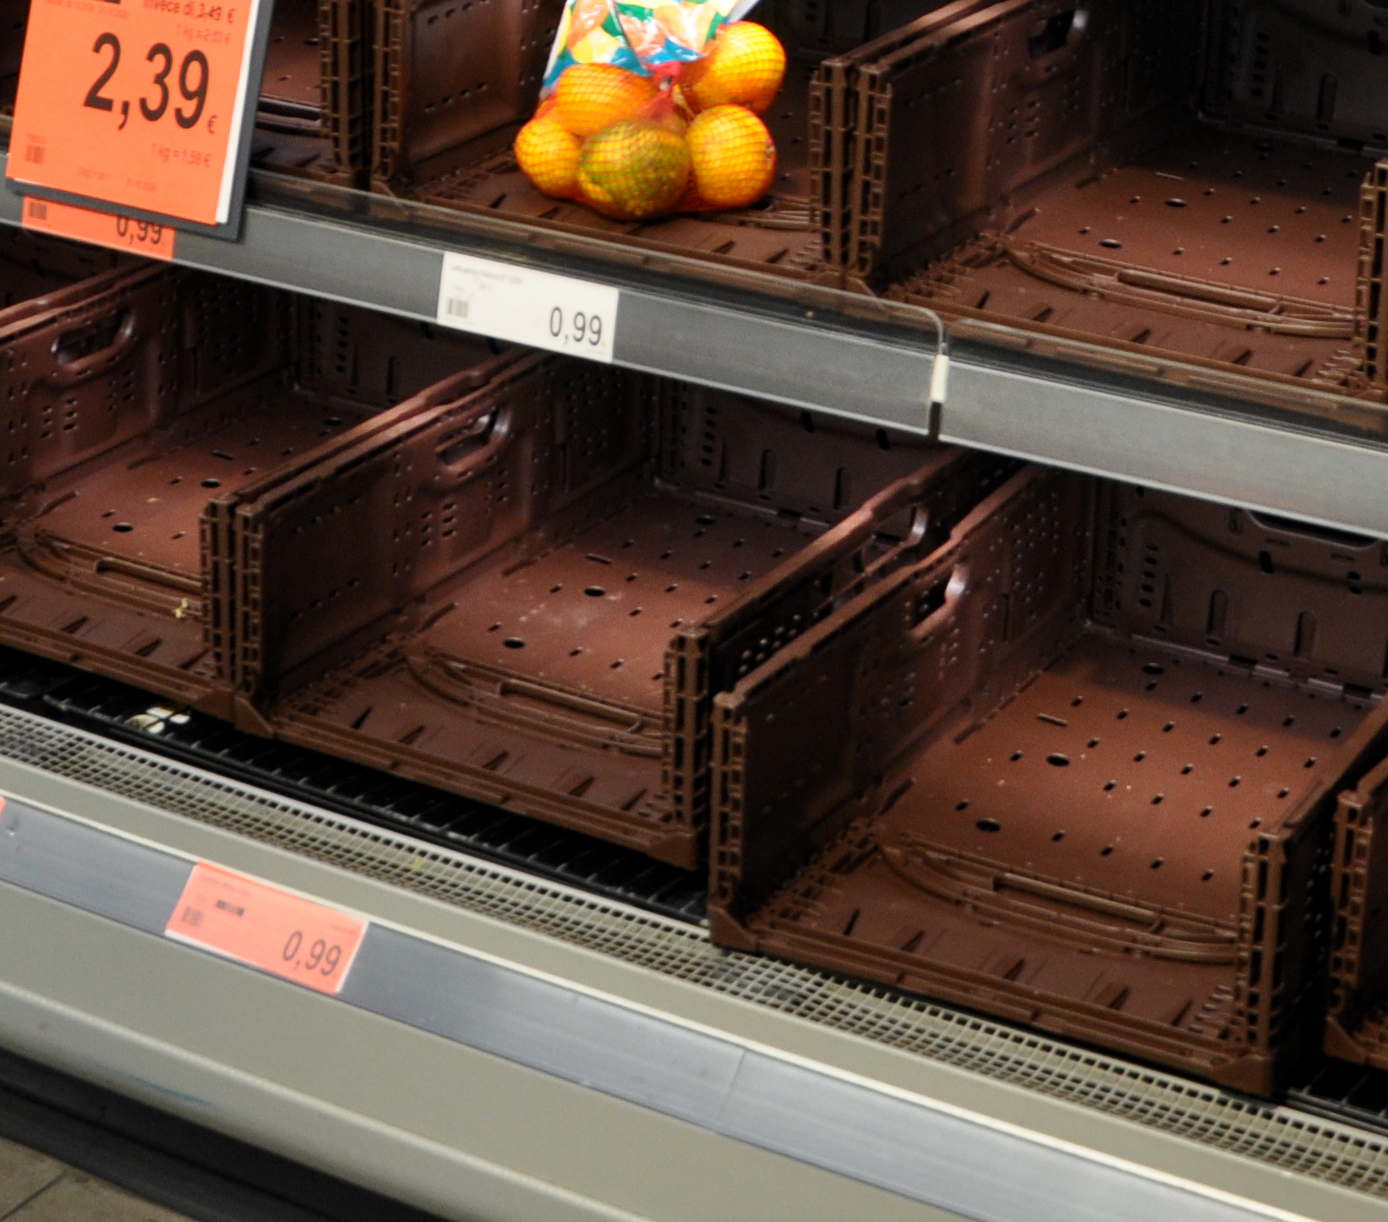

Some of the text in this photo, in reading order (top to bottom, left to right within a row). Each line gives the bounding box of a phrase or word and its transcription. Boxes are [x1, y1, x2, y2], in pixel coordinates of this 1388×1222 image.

[184, 0, 195, 17] di
[226, 7, 236, 25] €
[83, 31, 218, 135] 2,39 €
[116, 216, 163, 245] 0,99
[549, 305, 603, 347] 0,99
[282, 930, 342, 976] 0,99
